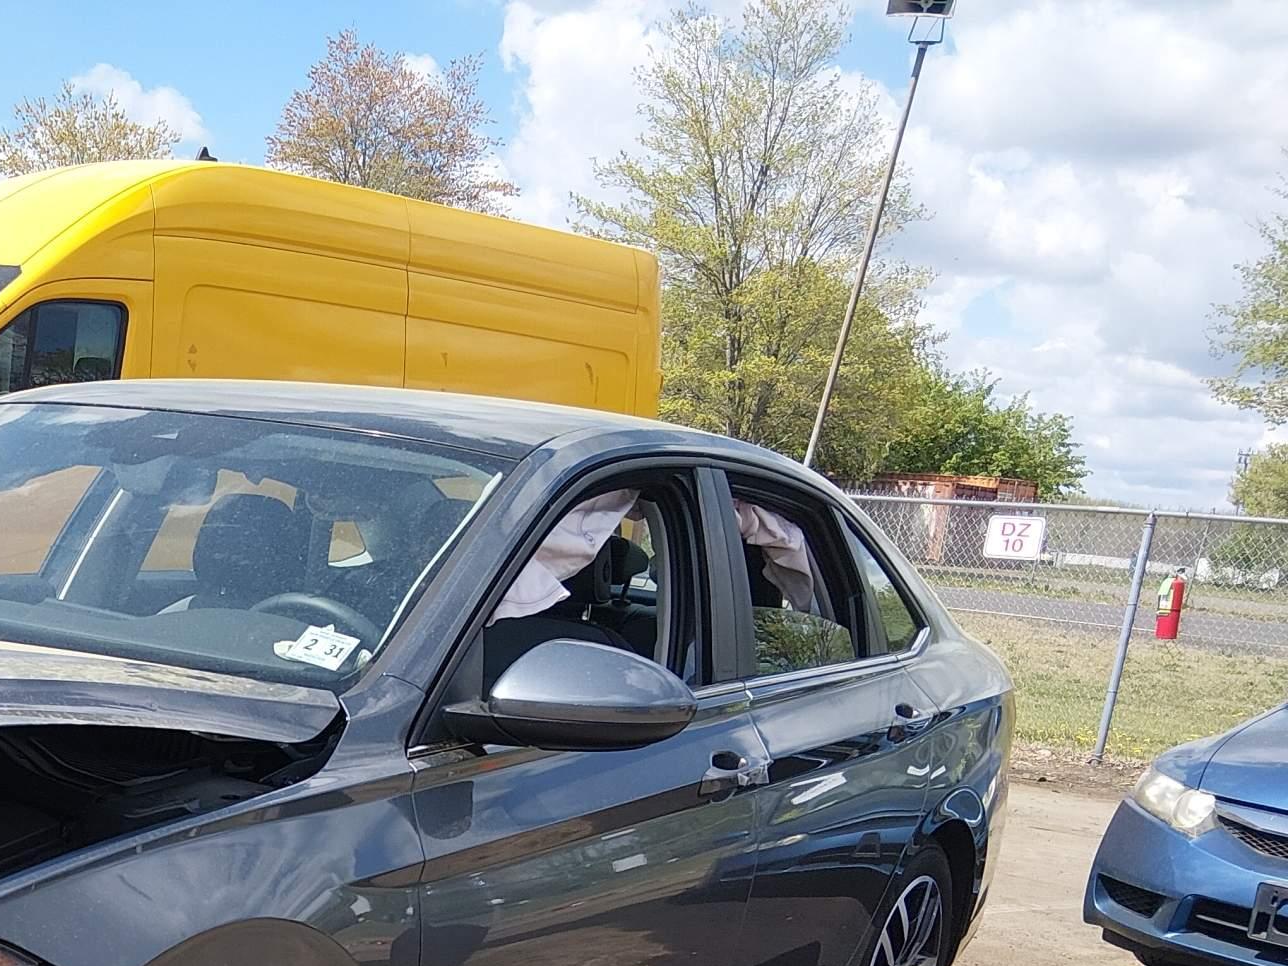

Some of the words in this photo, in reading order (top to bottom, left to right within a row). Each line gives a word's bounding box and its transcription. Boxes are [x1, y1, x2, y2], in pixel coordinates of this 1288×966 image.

[1001, 521, 1032, 537] DZ
[1002, 538, 1024, 552] 10
[303, 638, 319, 651] 2
[324, 644, 345, 659] 31
